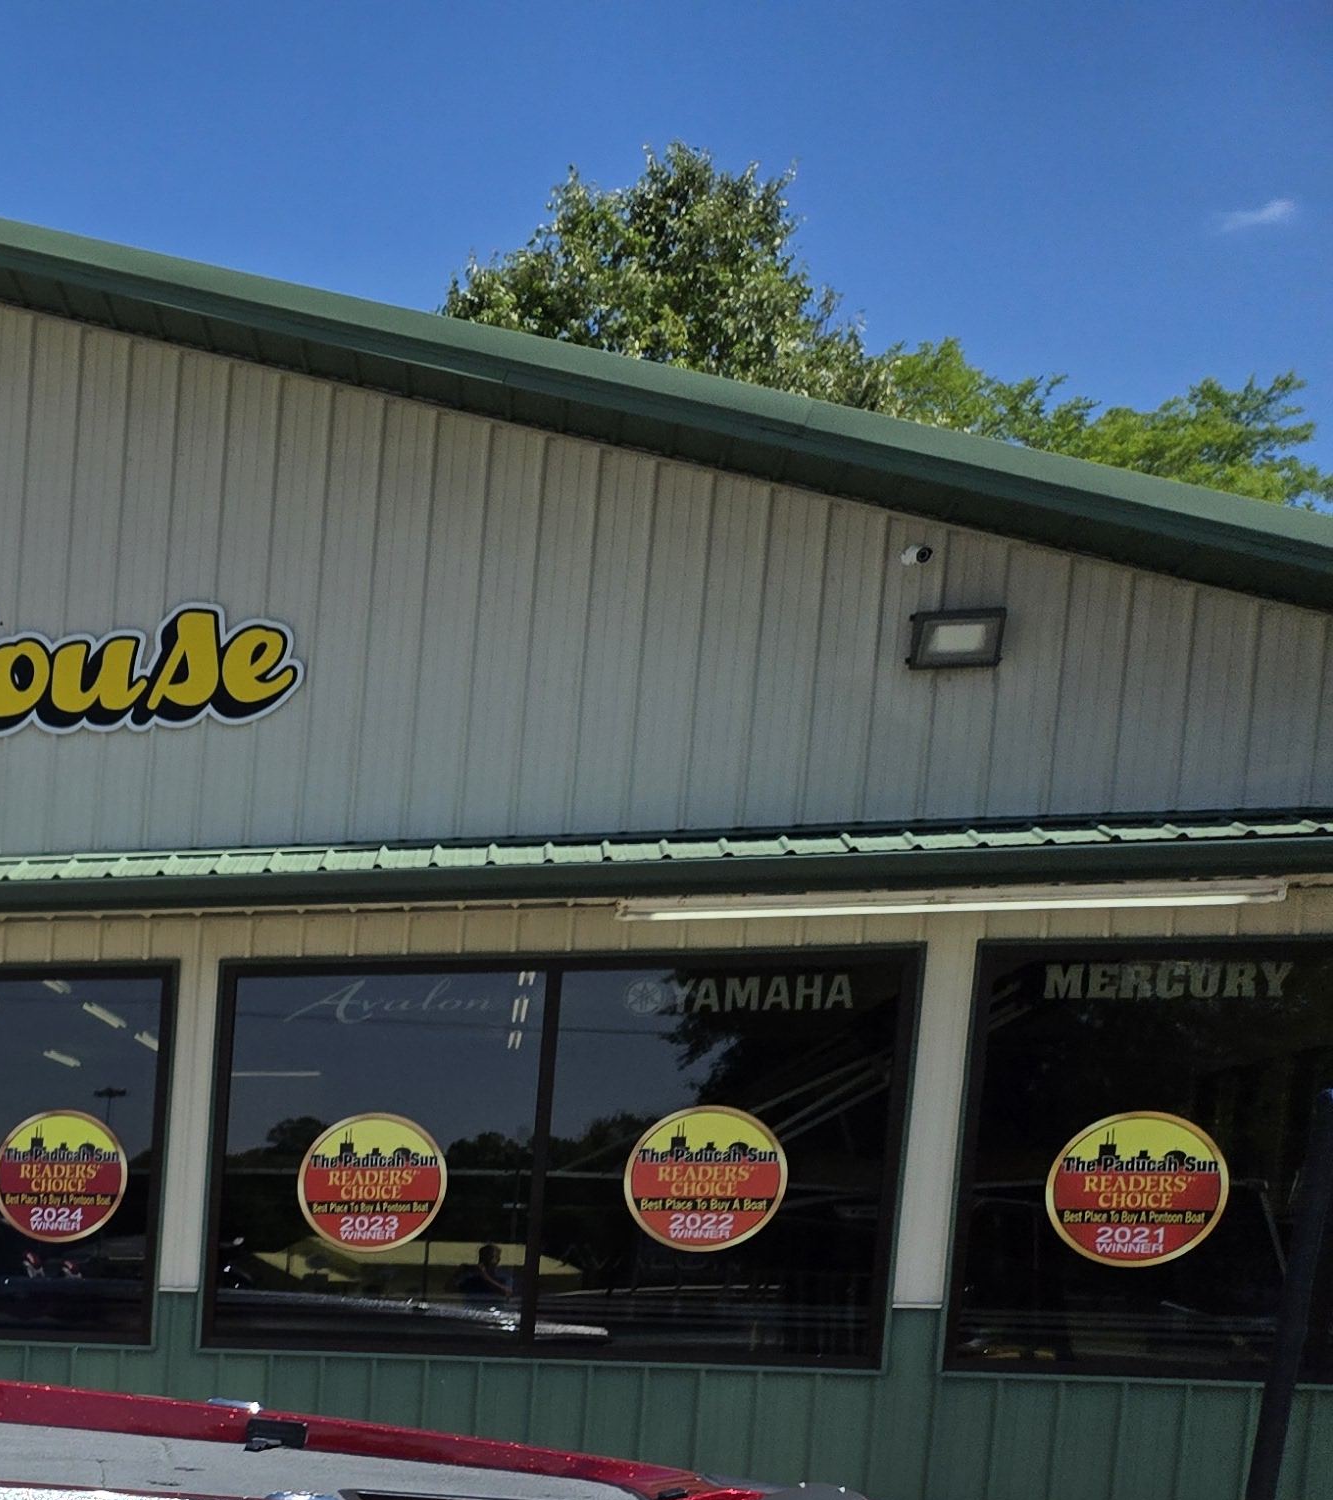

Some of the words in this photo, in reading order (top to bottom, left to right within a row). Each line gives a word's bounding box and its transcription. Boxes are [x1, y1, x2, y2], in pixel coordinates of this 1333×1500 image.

[1044, 960, 1294, 1000] MERCURY
[283, 977, 497, 1024] Avalon
[671, 973, 854, 1013] YAMAHA
[5, 1148, 29, 1162] The
[33, 1146, 91, 1162] Paducah
[93, 1148, 119, 1162] Sun
[311, 1155, 339, 1168] The
[343, 1153, 405, 1168] Paducah
[410, 1153, 438, 1167] Sun
[639, 1149, 671, 1164] The
[674, 1147, 742, 1164] Paducah
[747, 1147, 779, 1163] Sun
[1063, 1157, 1097, 1173] The
[1101, 1155, 1178, 1173] Paducah
[1184, 1156, 1219, 1173] Sun
[31, 1179, 87, 1192] CHOICE
[341, 1185, 402, 1200] CHOICE
[670, 1181, 738, 1197] CHOICE
[641, 1198, 662, 1211] Best
[665, 1198, 693, 1211] Place
[696, 1198, 707, 1211] To
[710, 1199, 729, 1213] Buy
[732, 1199, 740, 1211] A
[743, 1199, 767, 1211] Boat
[1098, 1192, 1173, 1208] CHOICE
[30, 1207, 83, 1222] 2024
[669, 1213, 734, 1230] 2022
[1063, 1210, 1082, 1223] Best
[1084, 1211, 1107, 1223] Place
[1110, 1211, 1119, 1223] To
[1121, 1211, 1138, 1225] Buy
[1140, 1211, 1147, 1223] A
[1149, 1211, 1183, 1223] Pontoon
[1185, 1211, 1205, 1223] Boat
[31, 1221, 81, 1231] WINNER
[339, 1215, 399, 1231] 2023
[340, 1230, 396, 1240] WINNER
[669, 1228, 730, 1239] WINNER
[1095, 1227, 1165, 1243] 2021
[1096, 1242, 1163, 1253] WINNER
